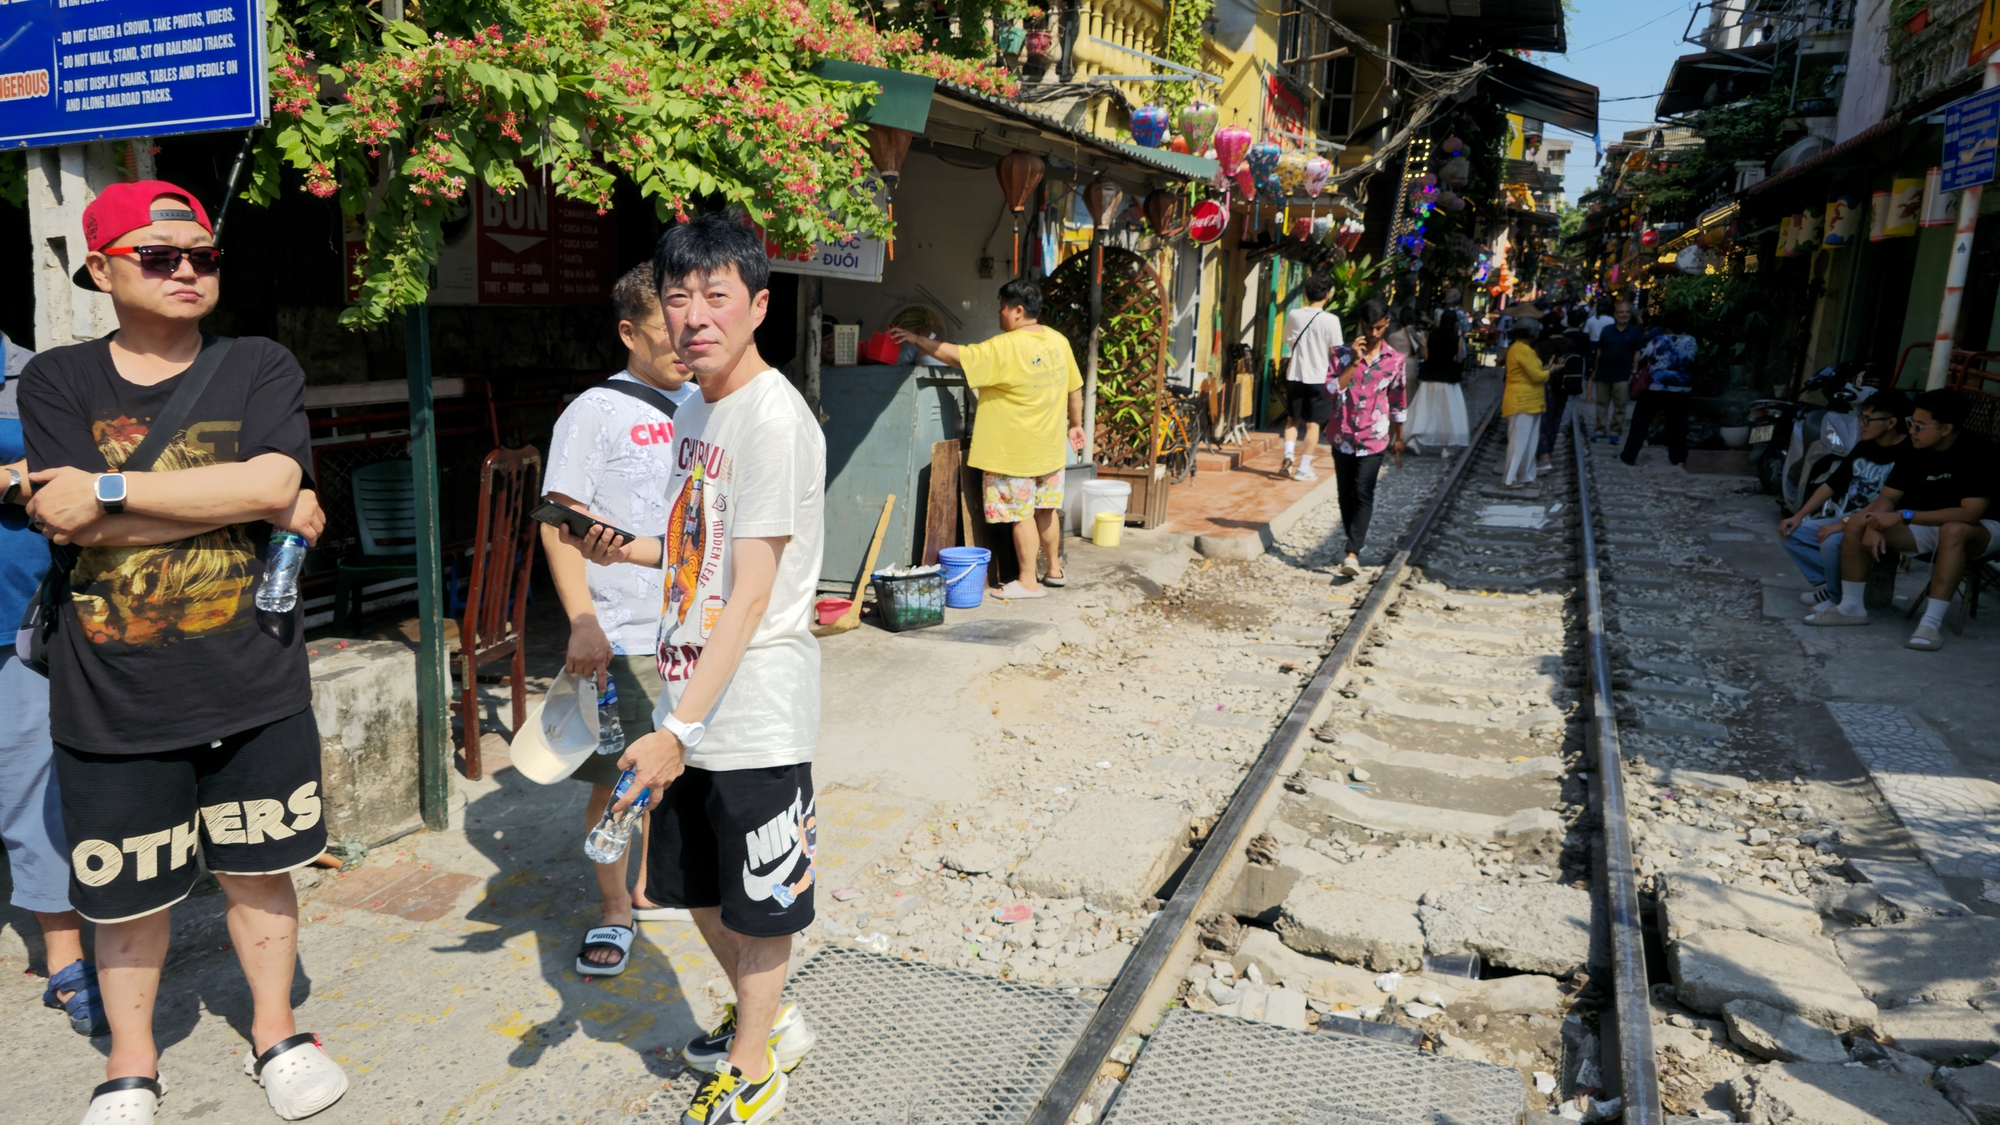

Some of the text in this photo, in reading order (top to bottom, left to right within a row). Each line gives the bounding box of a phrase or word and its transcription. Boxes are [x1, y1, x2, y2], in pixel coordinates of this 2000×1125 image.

[62, 31, 72, 45] DO
[73, 29, 87, 44] NOT
[88, 24, 115, 42] GATHER
[116, 24, 122, 38] A
[124, 19, 152, 36] CROWD,
[152, 16, 172, 32] TAKE
[172, 12, 205, 30] PHOTOS,
[206, 7, 236, 24] VIDEOS.
[64, 55, 73, 69] DO
[74, 53, 88, 68] NOT
[90, 50, 112, 66] WALK,
[114, 46, 140, 62] STAND,
[140, 44, 152, 59] SIT
[154, 43, 164, 58] ON
[166, 38, 203, 56] RAILROAD
[204, 33, 236, 51] TRACKS.
[64, 80, 73, 94] DO
[74, 78, 88, 92] NOT
[90, 74, 118, 90] DISPLAY
[120, 70, 149, 87] CHAIRS,
[150, 67, 177, 84] TABLES
[179, 65, 195, 80] AND
[196, 61, 225, 78] PEDDLE
[226, 60, 238, 74] ON
[66, 88, 172, 112] AND ALONG RAILROAD TRACKS.
[564, 224, 598, 235] COCA-COLA
[564, 238, 580, 248] COCA
[822, 252, 858, 268] ĐUÔI
[710, 519, 724, 560] HIDDEN
[698, 561, 718, 589] LEAF
[72, 780, 322, 888] OTHERS
[591, 932, 618, 940] PUMA
